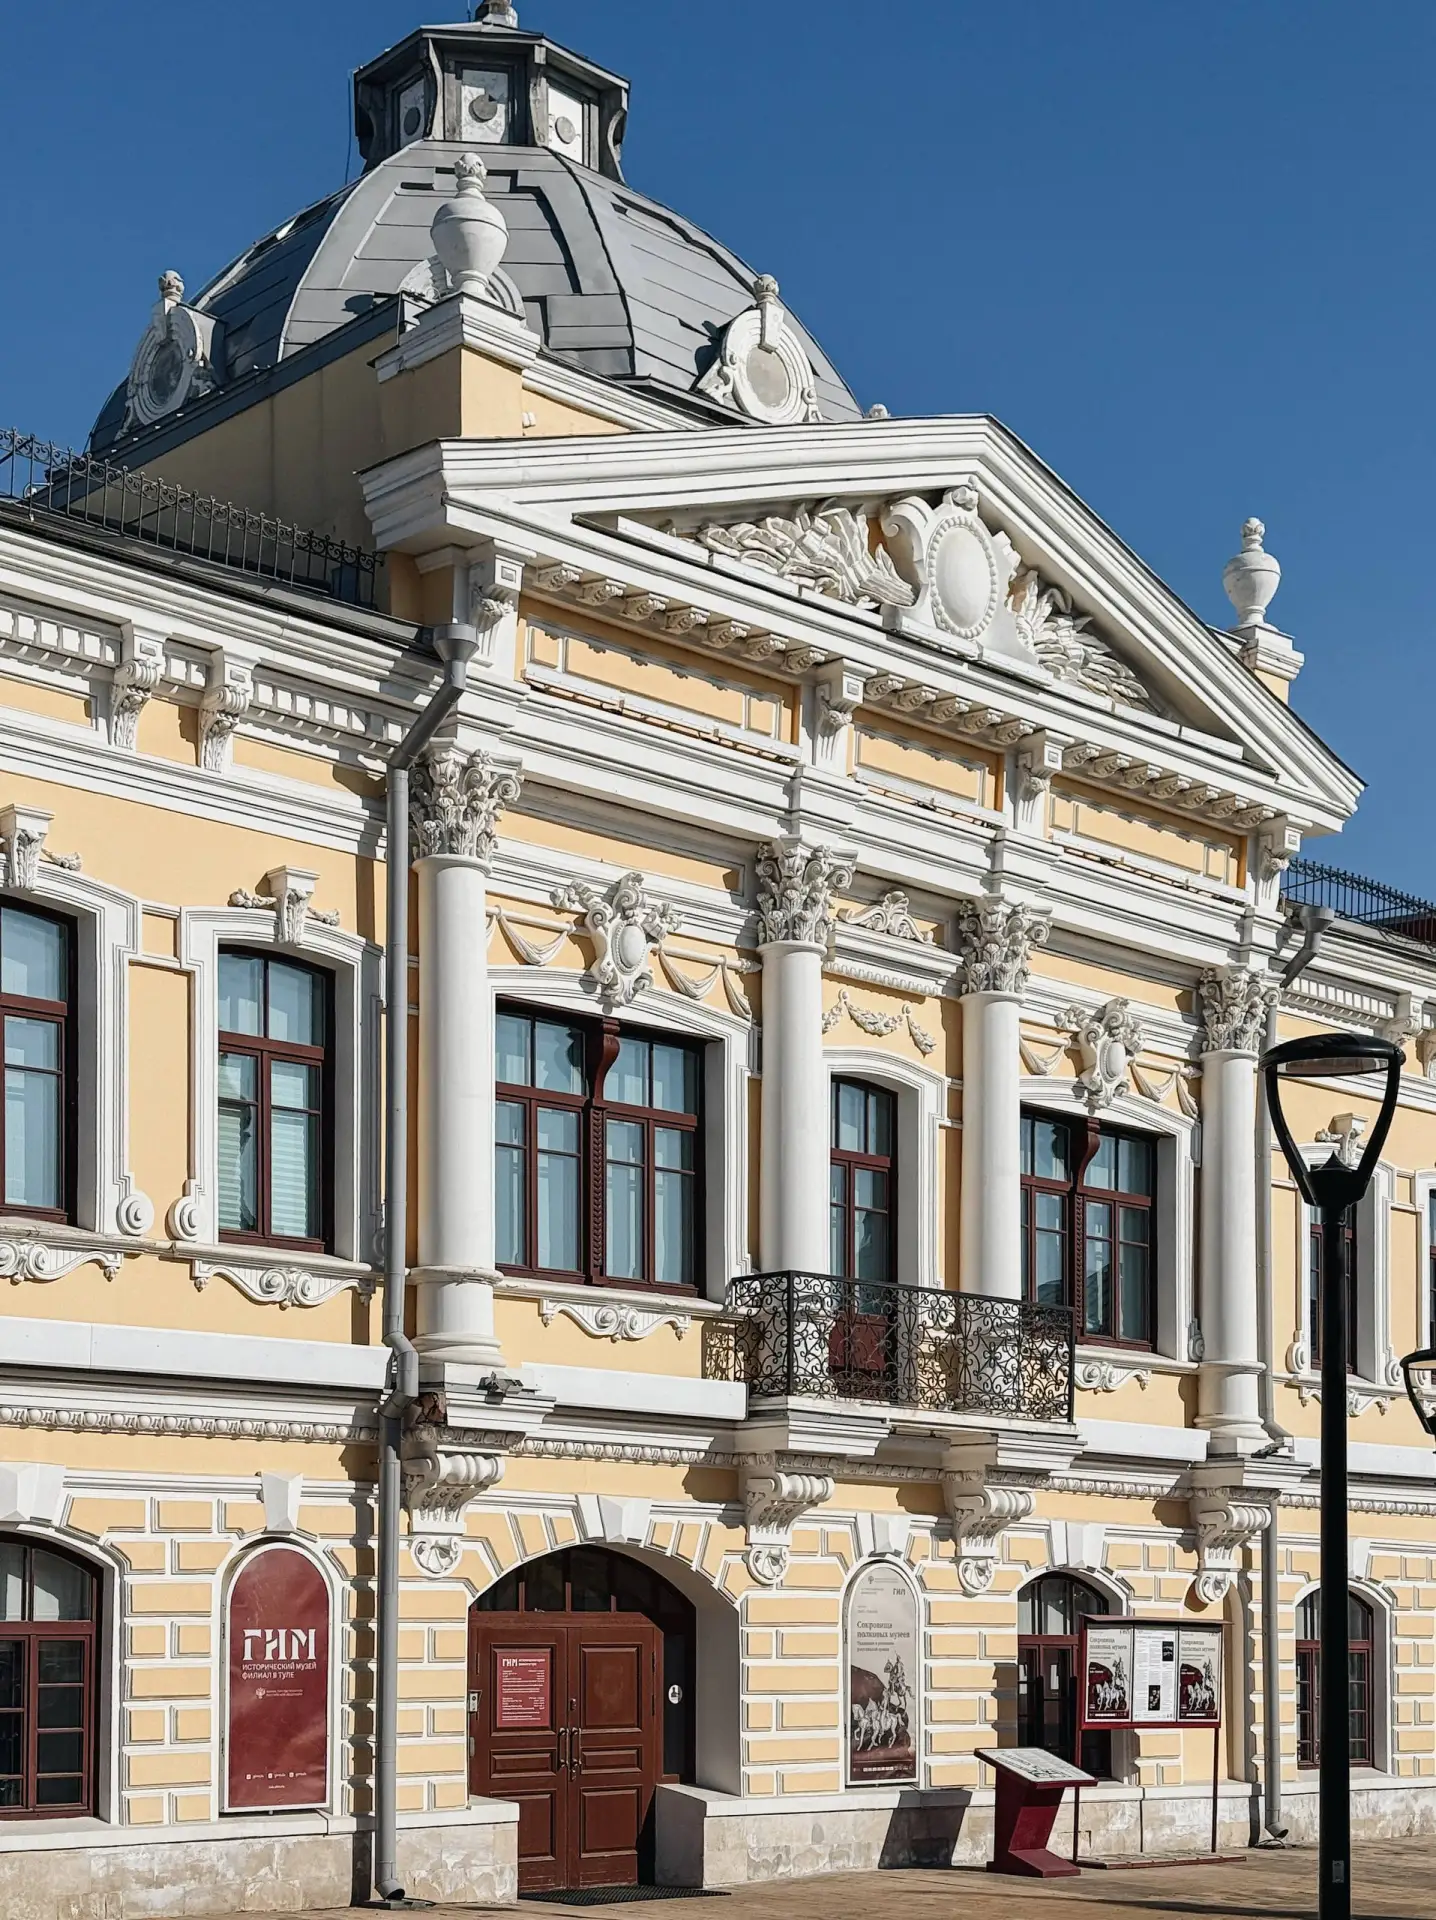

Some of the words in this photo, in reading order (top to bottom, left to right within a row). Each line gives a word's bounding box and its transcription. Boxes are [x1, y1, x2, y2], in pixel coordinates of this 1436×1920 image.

[857, 1621, 893, 1631] Сокровища
[243, 1629, 317, 1661] ГИМ
[242, 1662, 295, 1671] ИСТОРИЧЕСКИЙ
[295, 1662, 317, 1671] МУЗЕЙ
[242, 1672, 272, 1680] ФИЛИАЛ
[278, 1672, 295, 1680] ТУЛЕ
